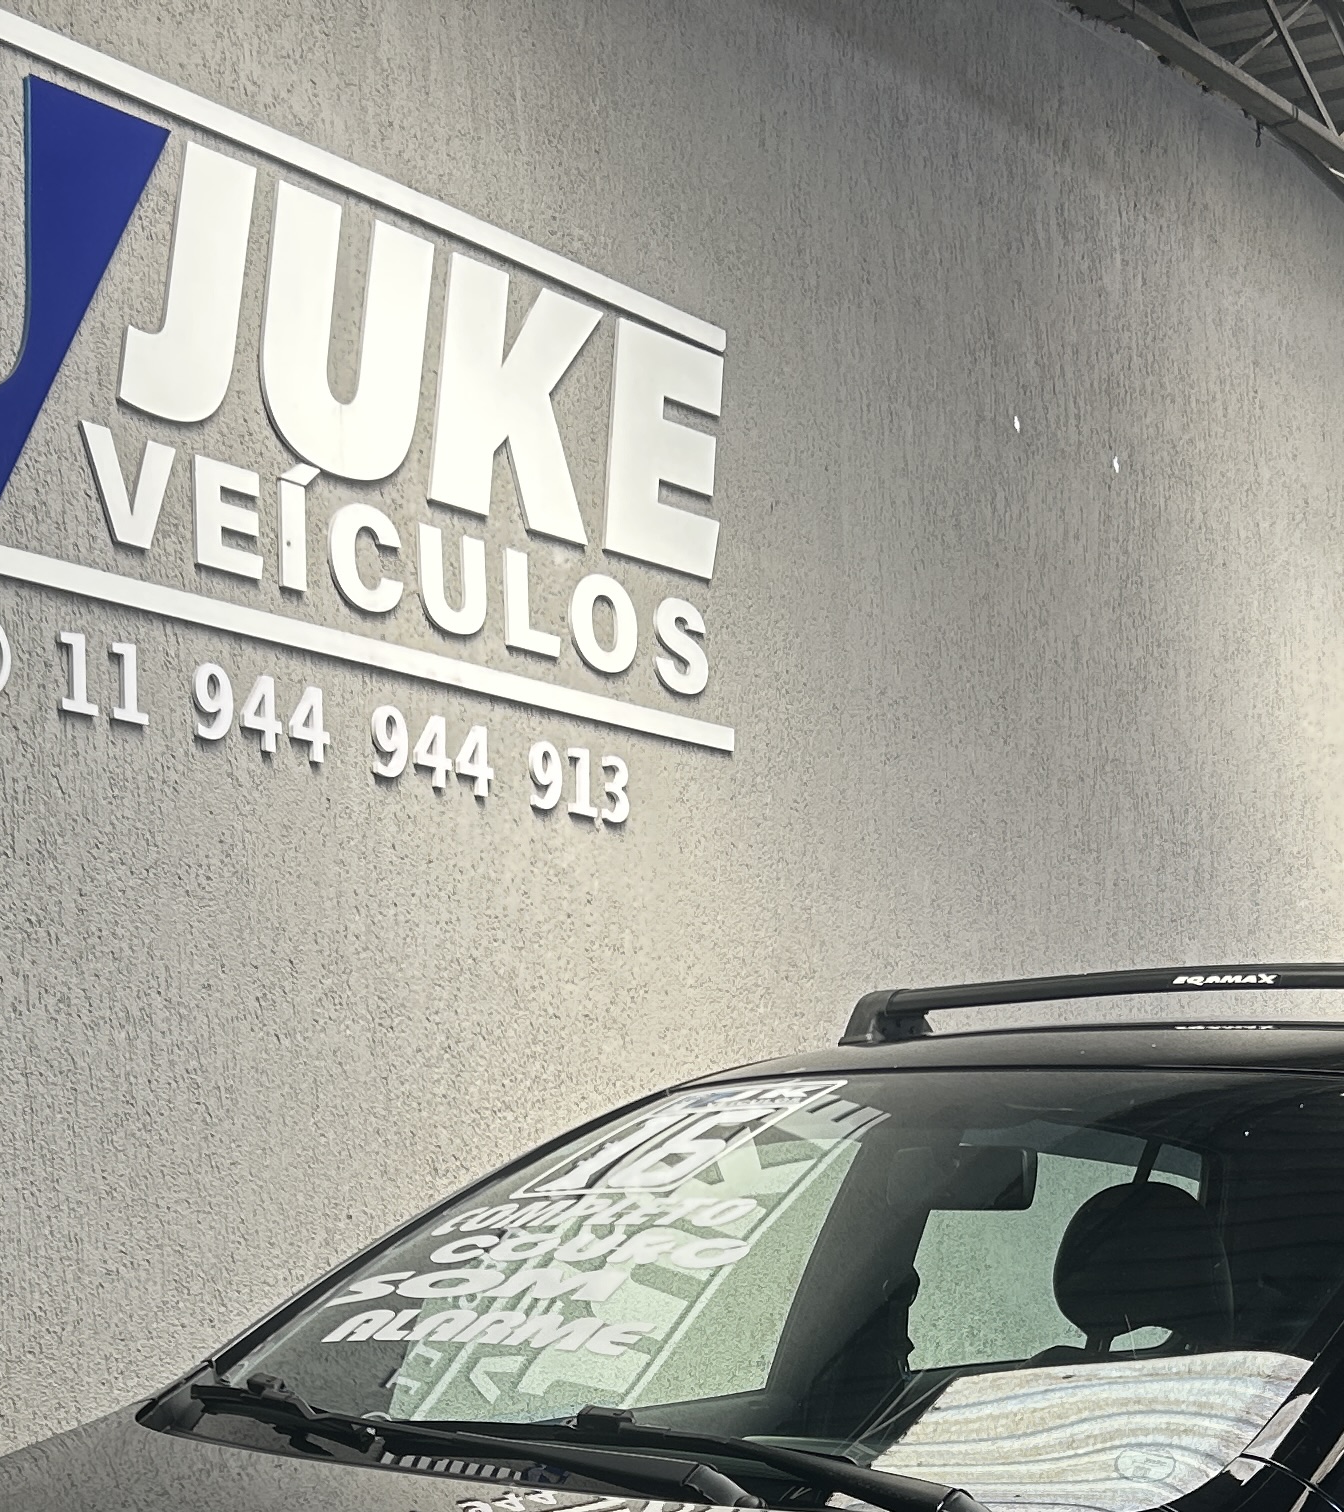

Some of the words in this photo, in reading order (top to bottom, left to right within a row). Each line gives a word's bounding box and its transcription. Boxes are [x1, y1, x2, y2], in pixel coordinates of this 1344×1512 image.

[117, 140, 724, 579] JUKE
[79, 419, 709, 695] VEÍCULOS
[59, 631, 149, 726] 11
[193, 662, 331, 764] 944
[370, 704, 494, 799] 944
[528, 740, 631, 824] 913
[432, 1197, 759, 1237] COMPLETO
[321, 1308, 659, 1356] ALARME
[326, 1267, 631, 1308] SOM
